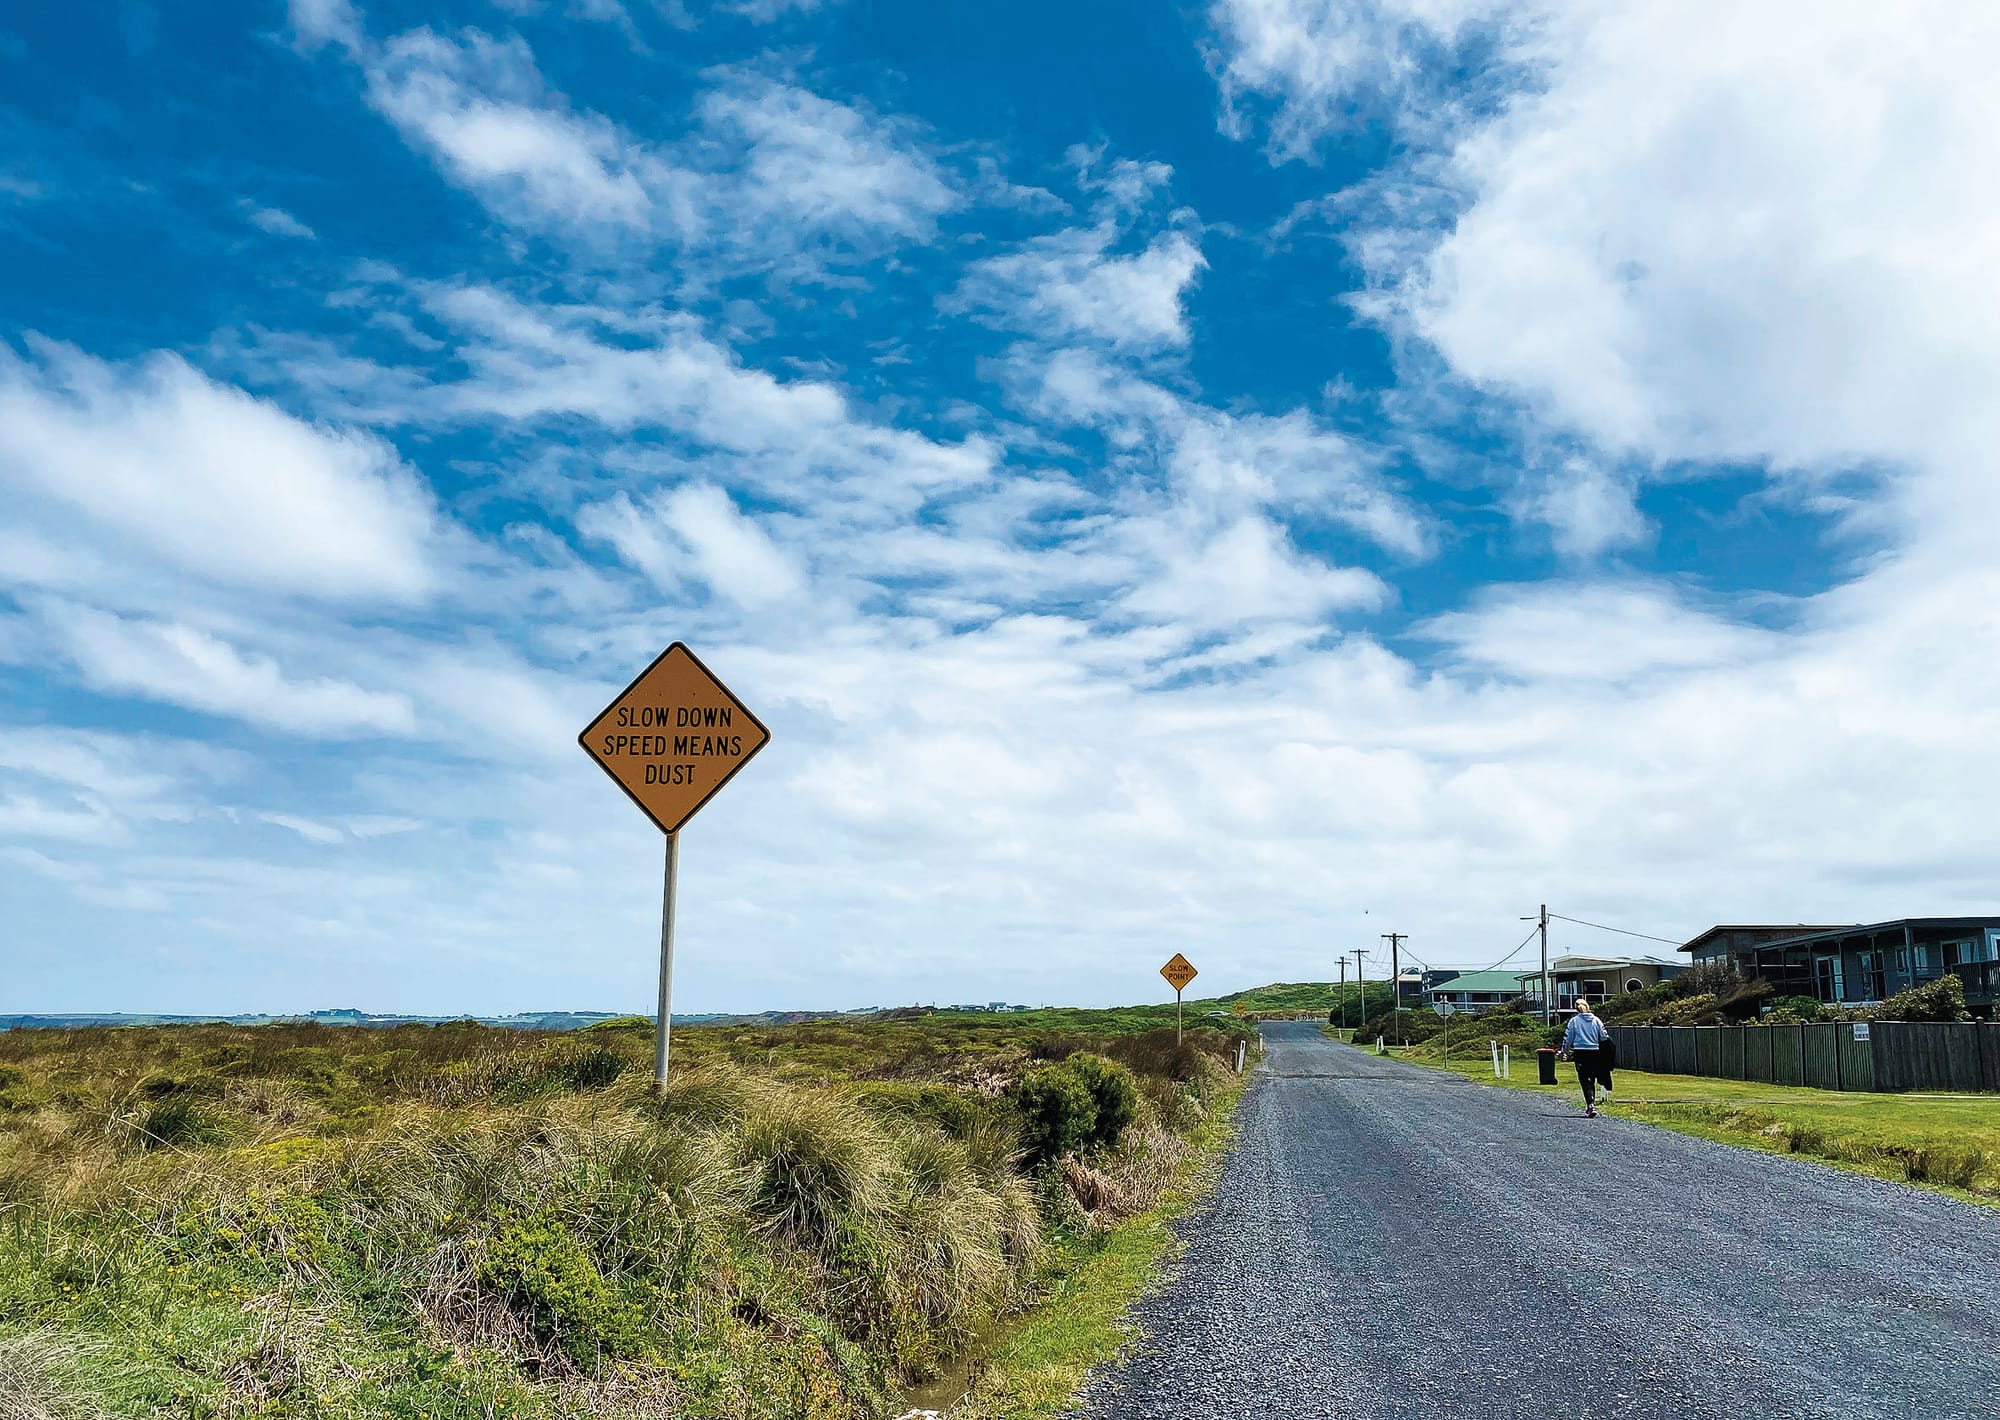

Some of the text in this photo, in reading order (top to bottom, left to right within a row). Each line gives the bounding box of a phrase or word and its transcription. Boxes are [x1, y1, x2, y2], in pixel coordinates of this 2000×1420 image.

[617, 706, 732, 728] SLOW DOWN
[602, 735, 742, 756] SPEED MEANS
[644, 764, 696, 785] DUST
[1168, 973, 1189, 981] POINT
